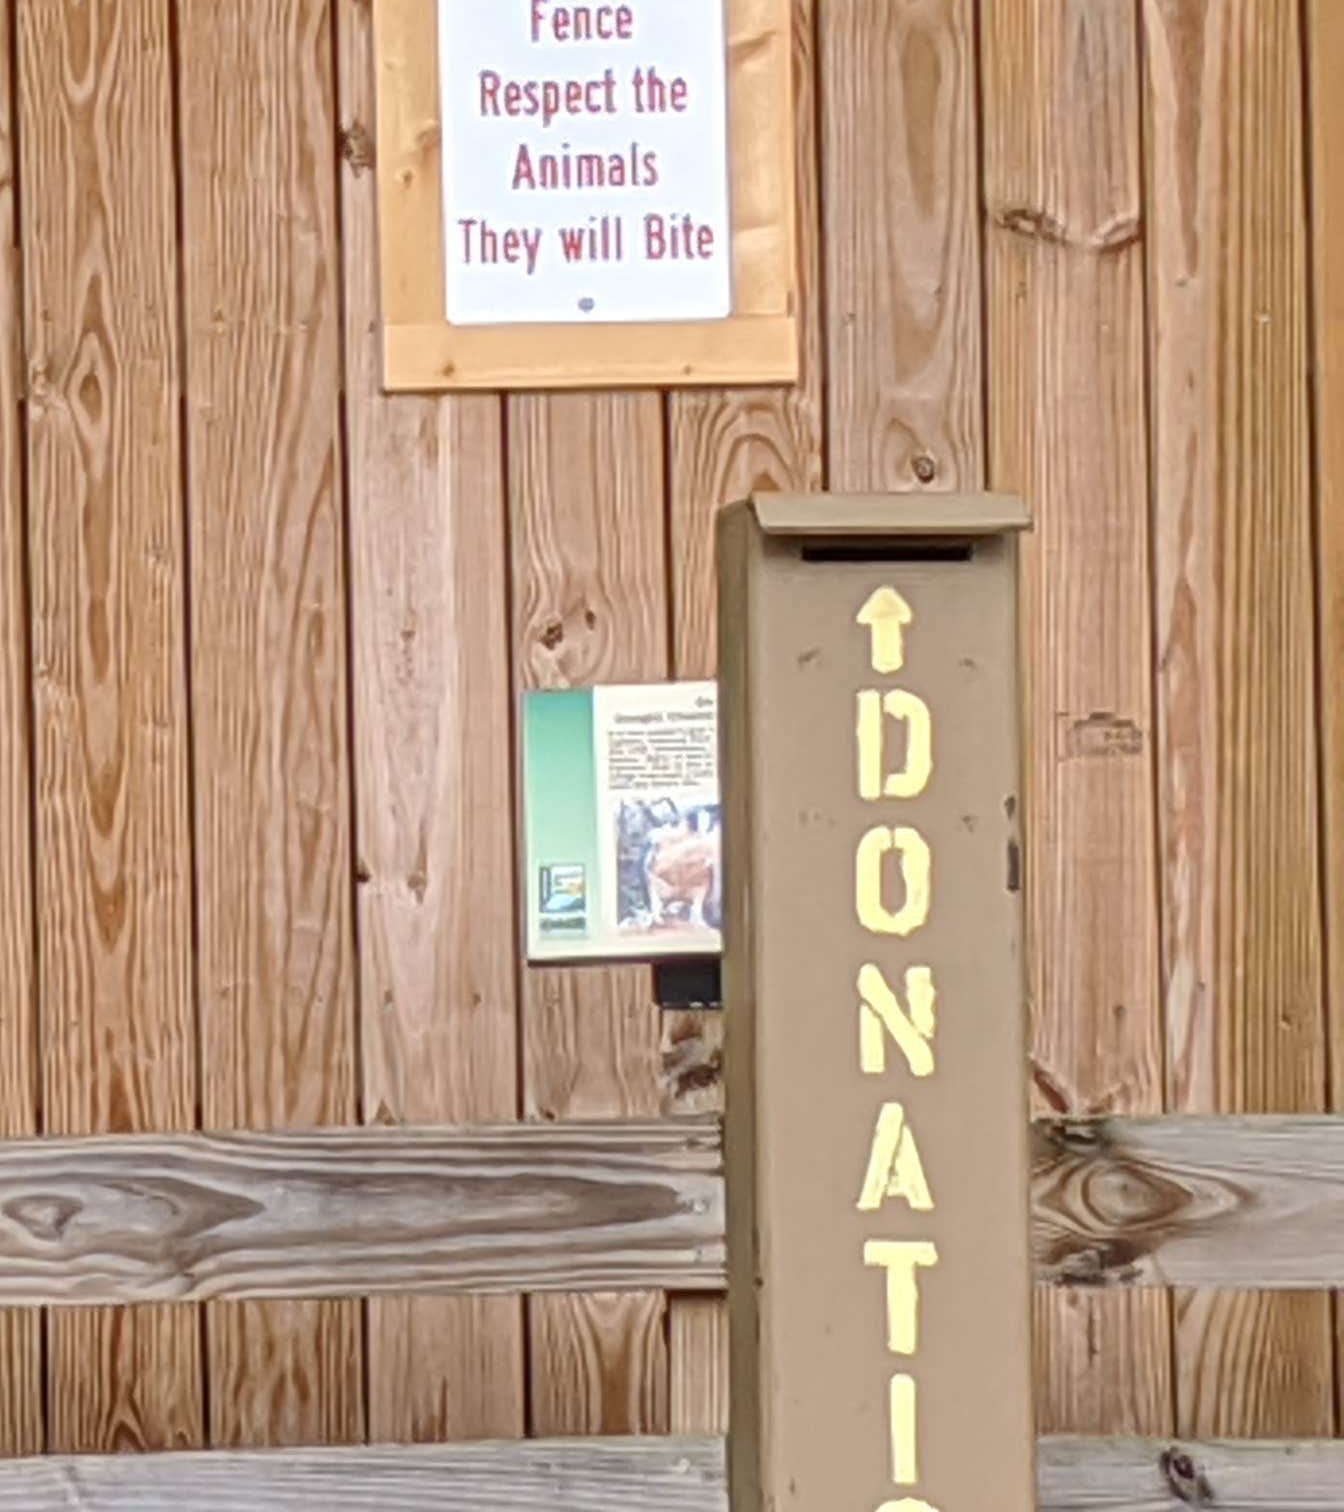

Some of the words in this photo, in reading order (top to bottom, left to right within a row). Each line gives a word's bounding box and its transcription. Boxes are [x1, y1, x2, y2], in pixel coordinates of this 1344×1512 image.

[478, 68, 617, 126] Respect
[632, 66, 688, 112] the
[512, 141, 659, 189] Animals
[458, 219, 543, 274] They
[560, 216, 623, 262] will
[645, 213, 715, 260] Bite
[855, 688, 939, 1512] DONATI
